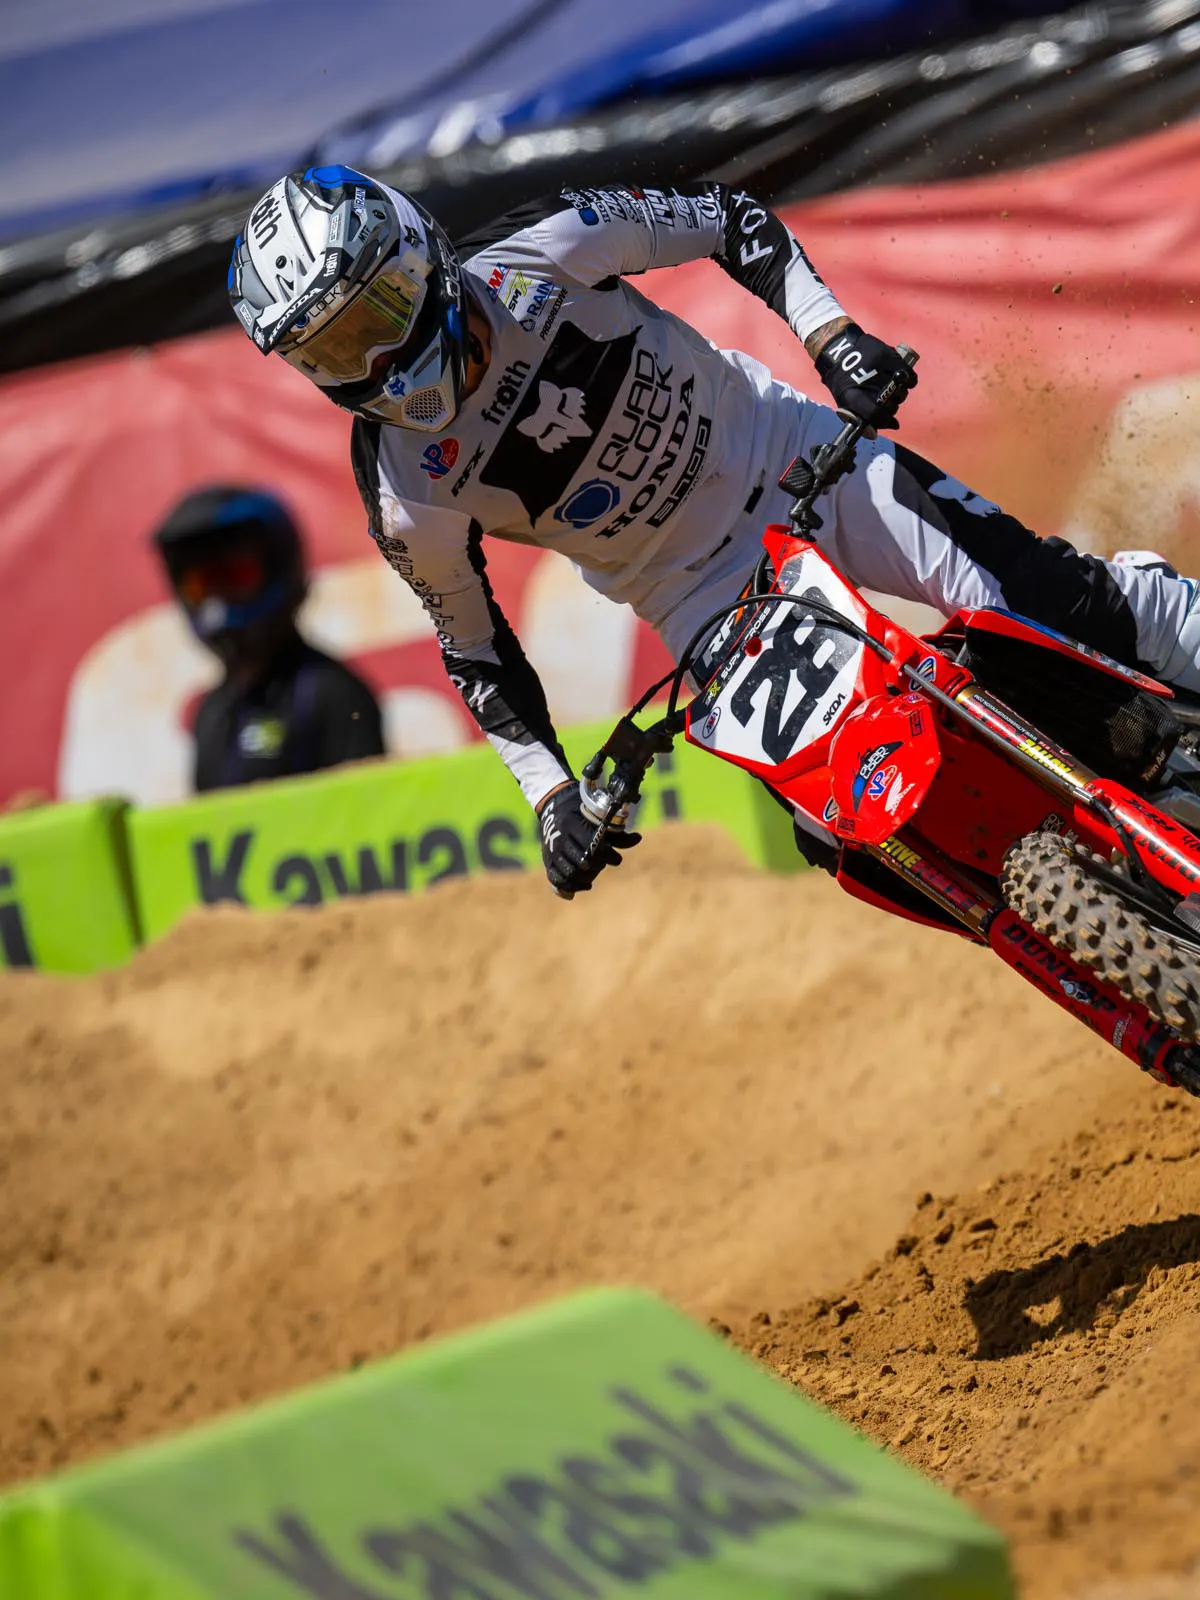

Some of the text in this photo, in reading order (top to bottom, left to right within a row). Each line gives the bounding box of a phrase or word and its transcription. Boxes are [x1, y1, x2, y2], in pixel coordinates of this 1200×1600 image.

[732, 190, 774, 267] FOX
[268, 285, 324, 344] HONDA
[311, 285, 342, 319] LOCK
[829, 338, 878, 385] FOX
[597, 349, 656, 473] QUAD
[616, 364, 674, 482] LOCK
[420, 443, 445, 476] VP
[451, 440, 485, 498] RFX
[595, 374, 695, 540] HONDA
[730, 586, 860, 766] 28
[822, 692, 847, 727] SKDA
[860, 747, 887, 778] QUAD
[868, 770, 885, 796] VP
[192, 752, 683, 909] Kawasi
[539, 800, 562, 852] FOX
